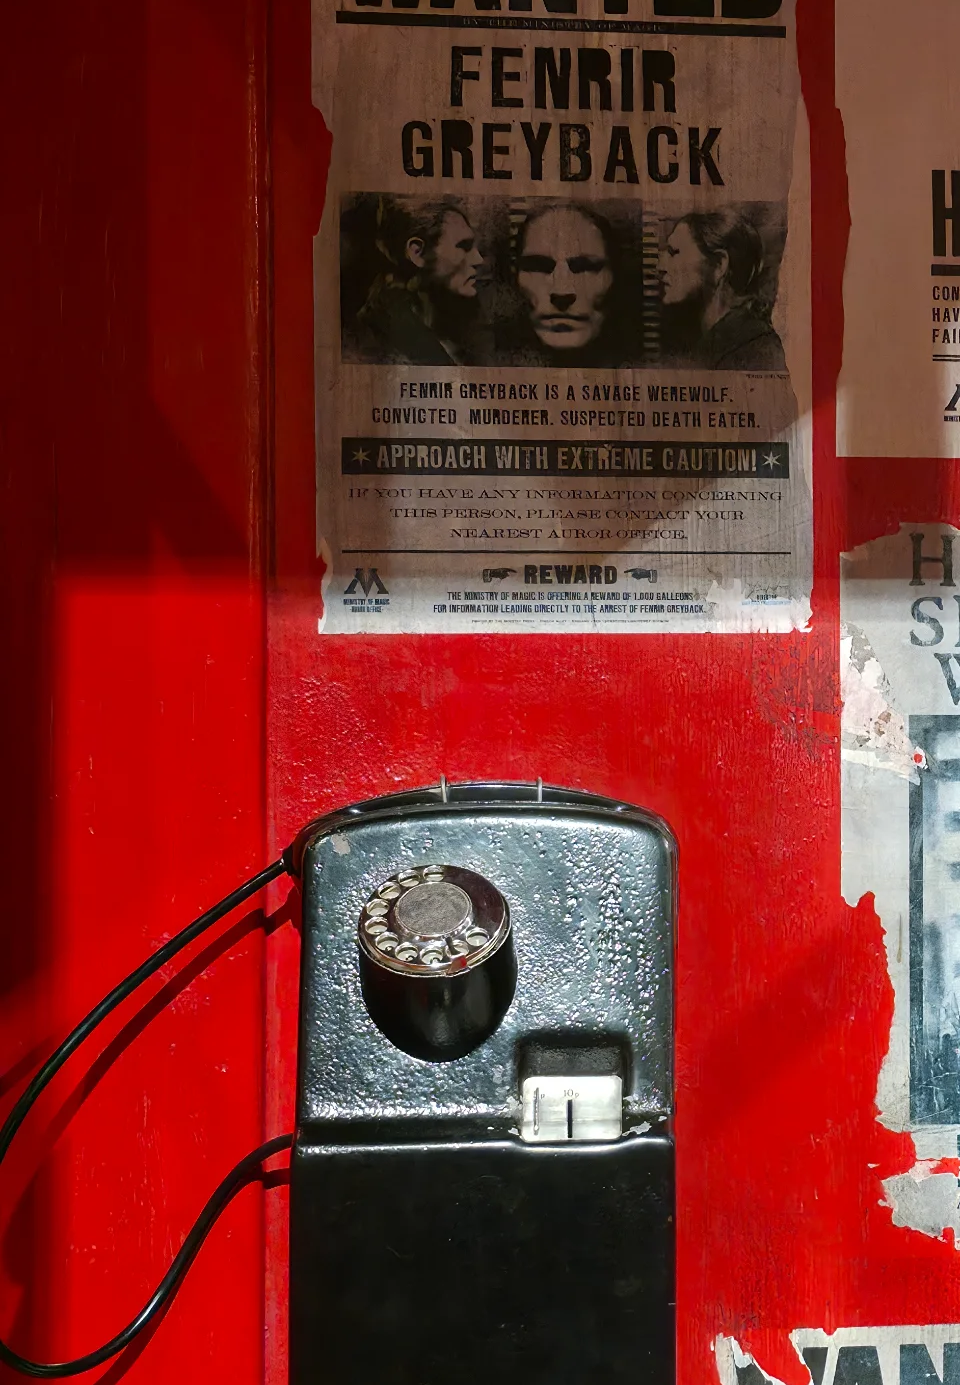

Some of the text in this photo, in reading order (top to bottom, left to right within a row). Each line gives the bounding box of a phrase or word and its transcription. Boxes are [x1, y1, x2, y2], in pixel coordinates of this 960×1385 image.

[450, 45, 677, 114] FENRIR
[401, 120, 725, 187] GREYBACK
[400, 382, 734, 403] FENRIR GREYBACK IS A SAVAGE WEREWOLF.
[371, 406, 760, 429] CONVICTED MURDERER. SUSPECTED DEATH EATER.
[377, 444, 757, 472] APPROACH WITH EXTREME CAUTION!
[348, 487, 781, 503] IF YOU HAVE ANY INFORMATION CONCERNING
[389, 507, 438, 520] THIS
[525, 508, 602, 520] PLEASE
[605, 508, 690, 522] CONTACT
[694, 510, 745, 523] YOUR
[449, 528, 543, 540] NEAREST
[547, 528, 611, 540] AUROR
[524, 564, 618, 585] REWARD
